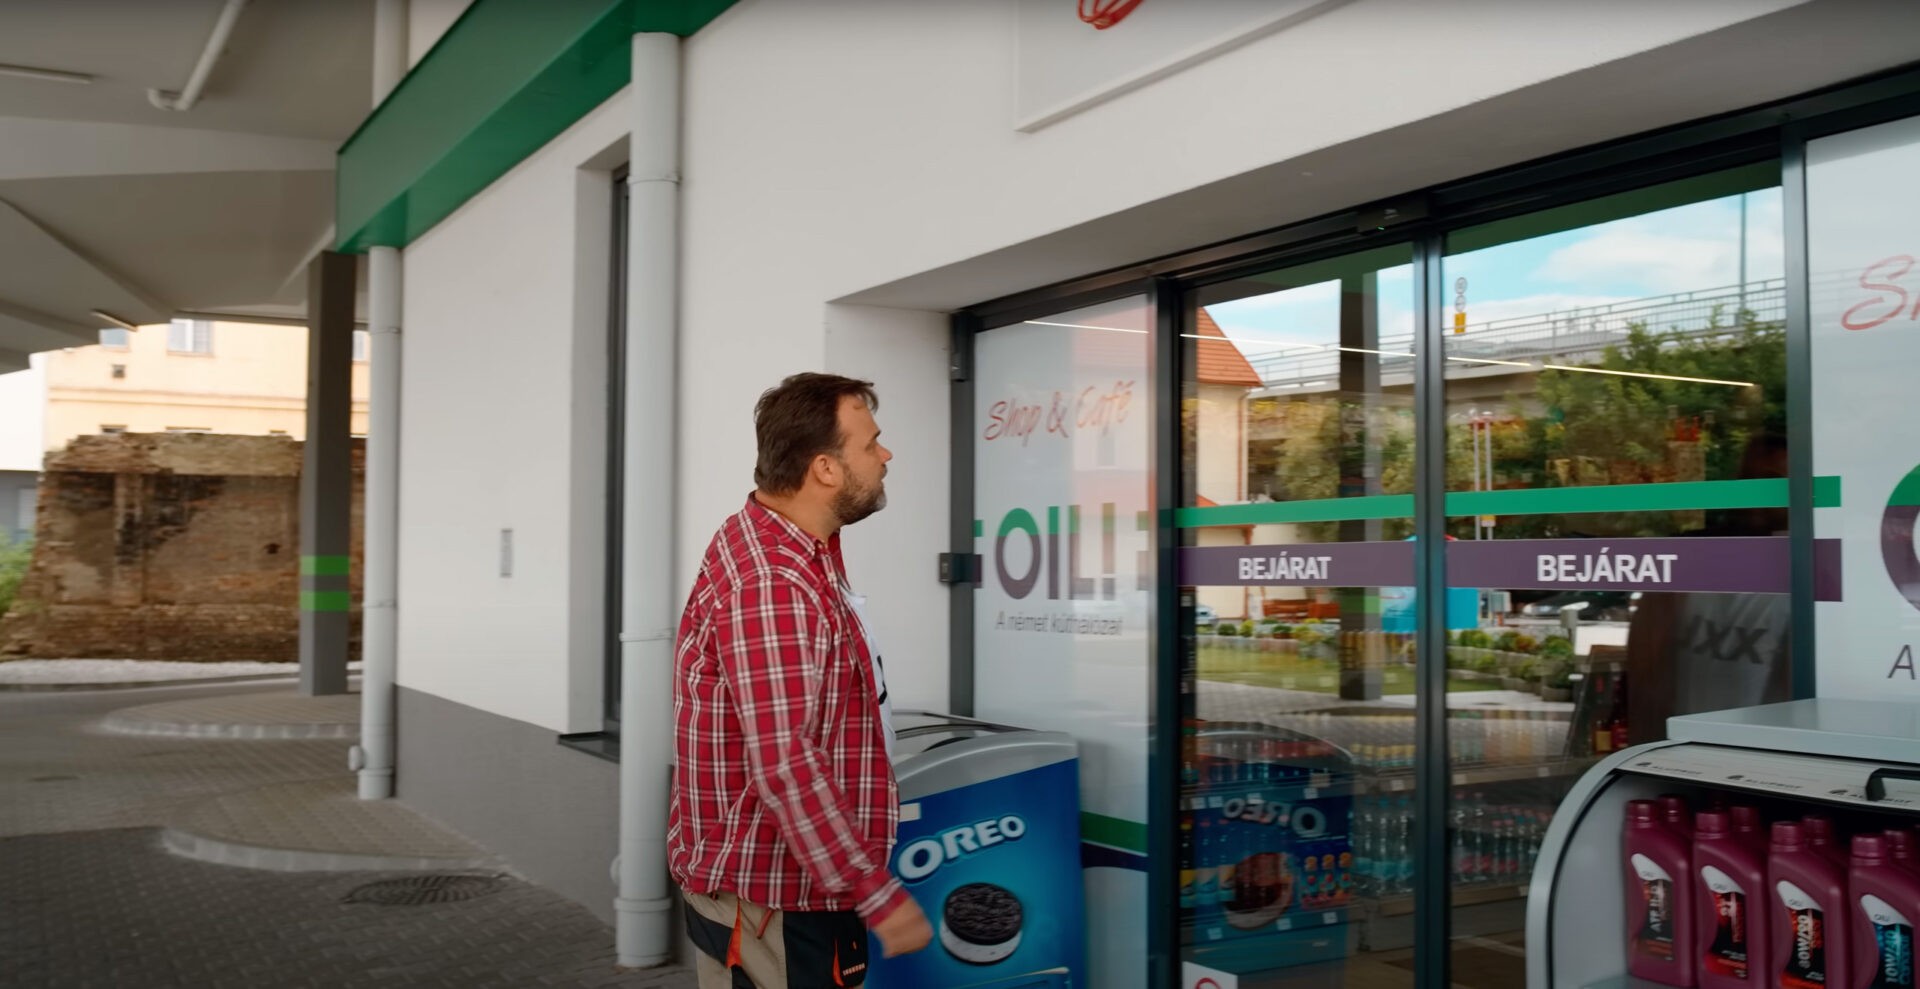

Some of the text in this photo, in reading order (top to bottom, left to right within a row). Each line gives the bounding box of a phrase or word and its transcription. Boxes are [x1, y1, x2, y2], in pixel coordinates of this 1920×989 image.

[983, 379, 1137, 448] Shop & Café
[1237, 550, 1332, 581] BEJÁRAT
[1537, 547, 1679, 584] BEJÁRAT
[995, 610, 1006, 630] A
[1008, 611, 1049, 633] német
[1887, 644, 1917, 681] A
[897, 815, 1026, 880] OREO
